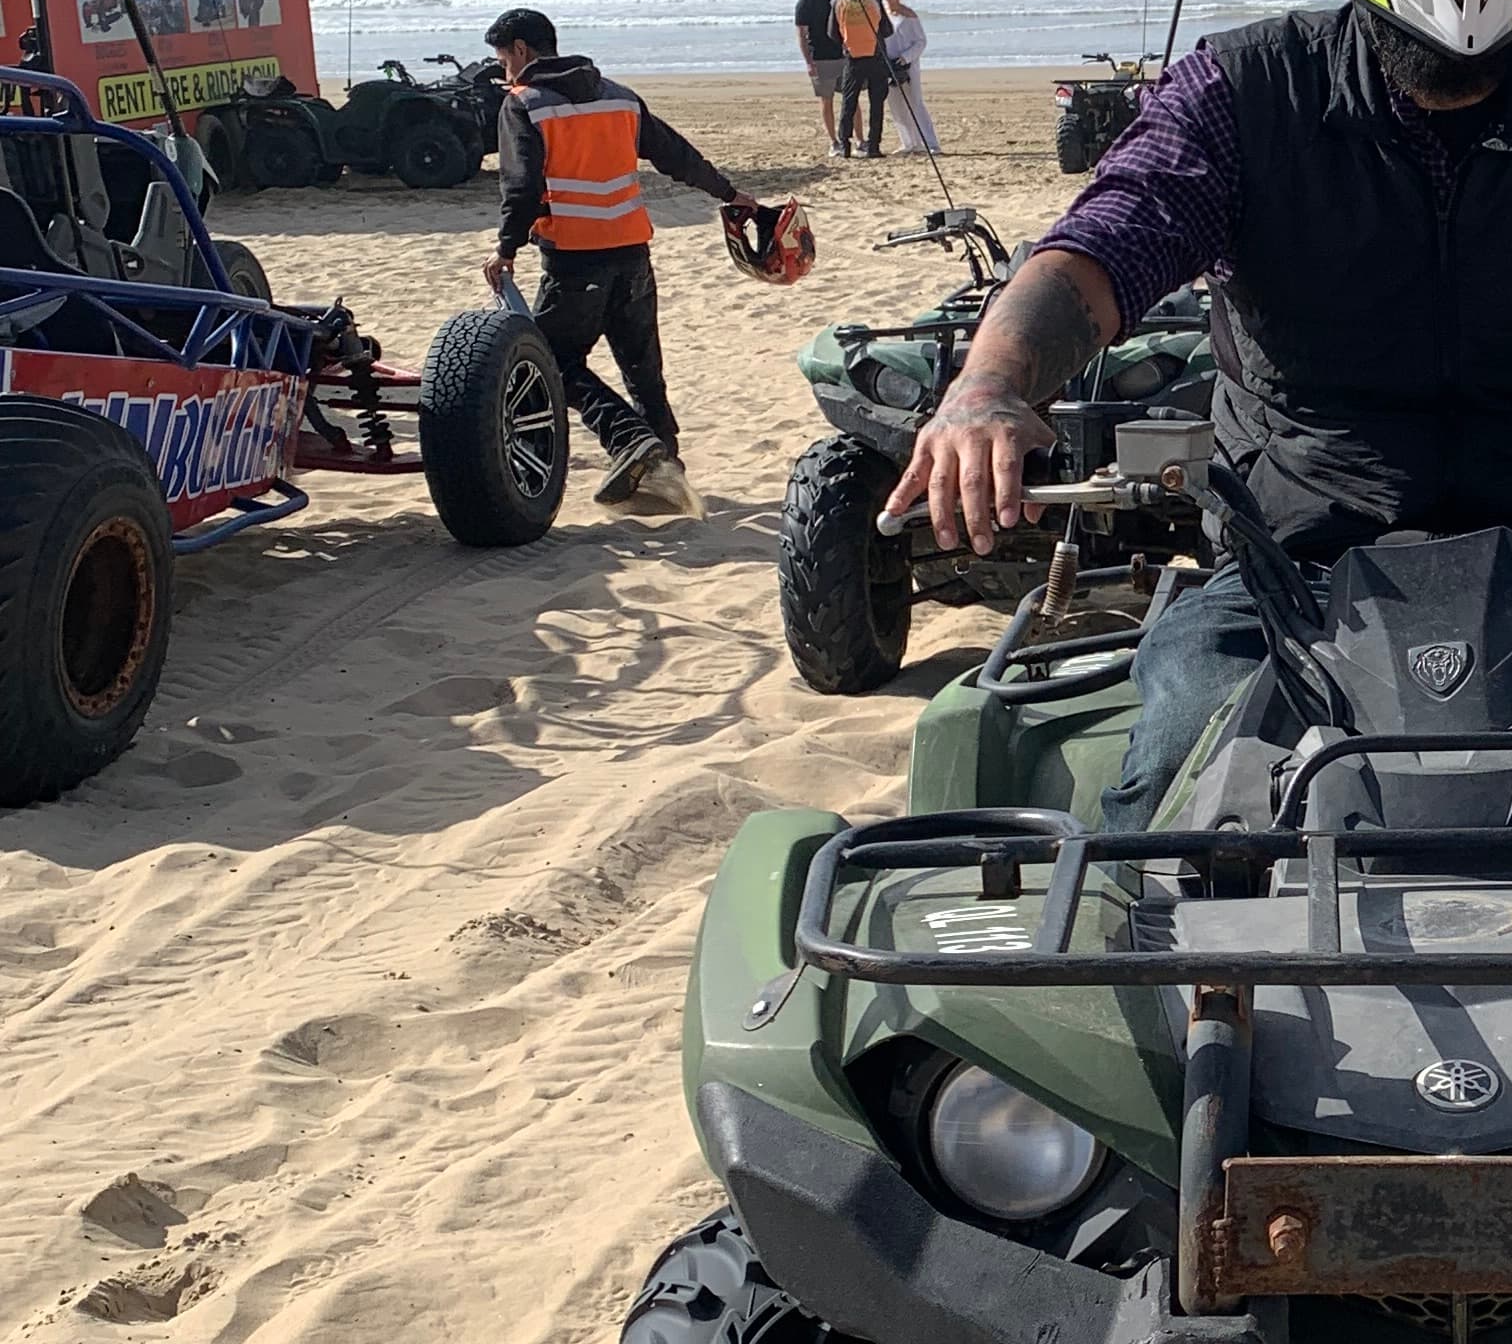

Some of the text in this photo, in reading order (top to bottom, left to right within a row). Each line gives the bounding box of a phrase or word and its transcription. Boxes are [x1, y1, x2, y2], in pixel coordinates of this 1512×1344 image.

[104, 78, 147, 118] RENT
[148, 75, 192, 114] HRE
[193, 72, 203, 102] &
[205, 67, 238, 103] RIDE
